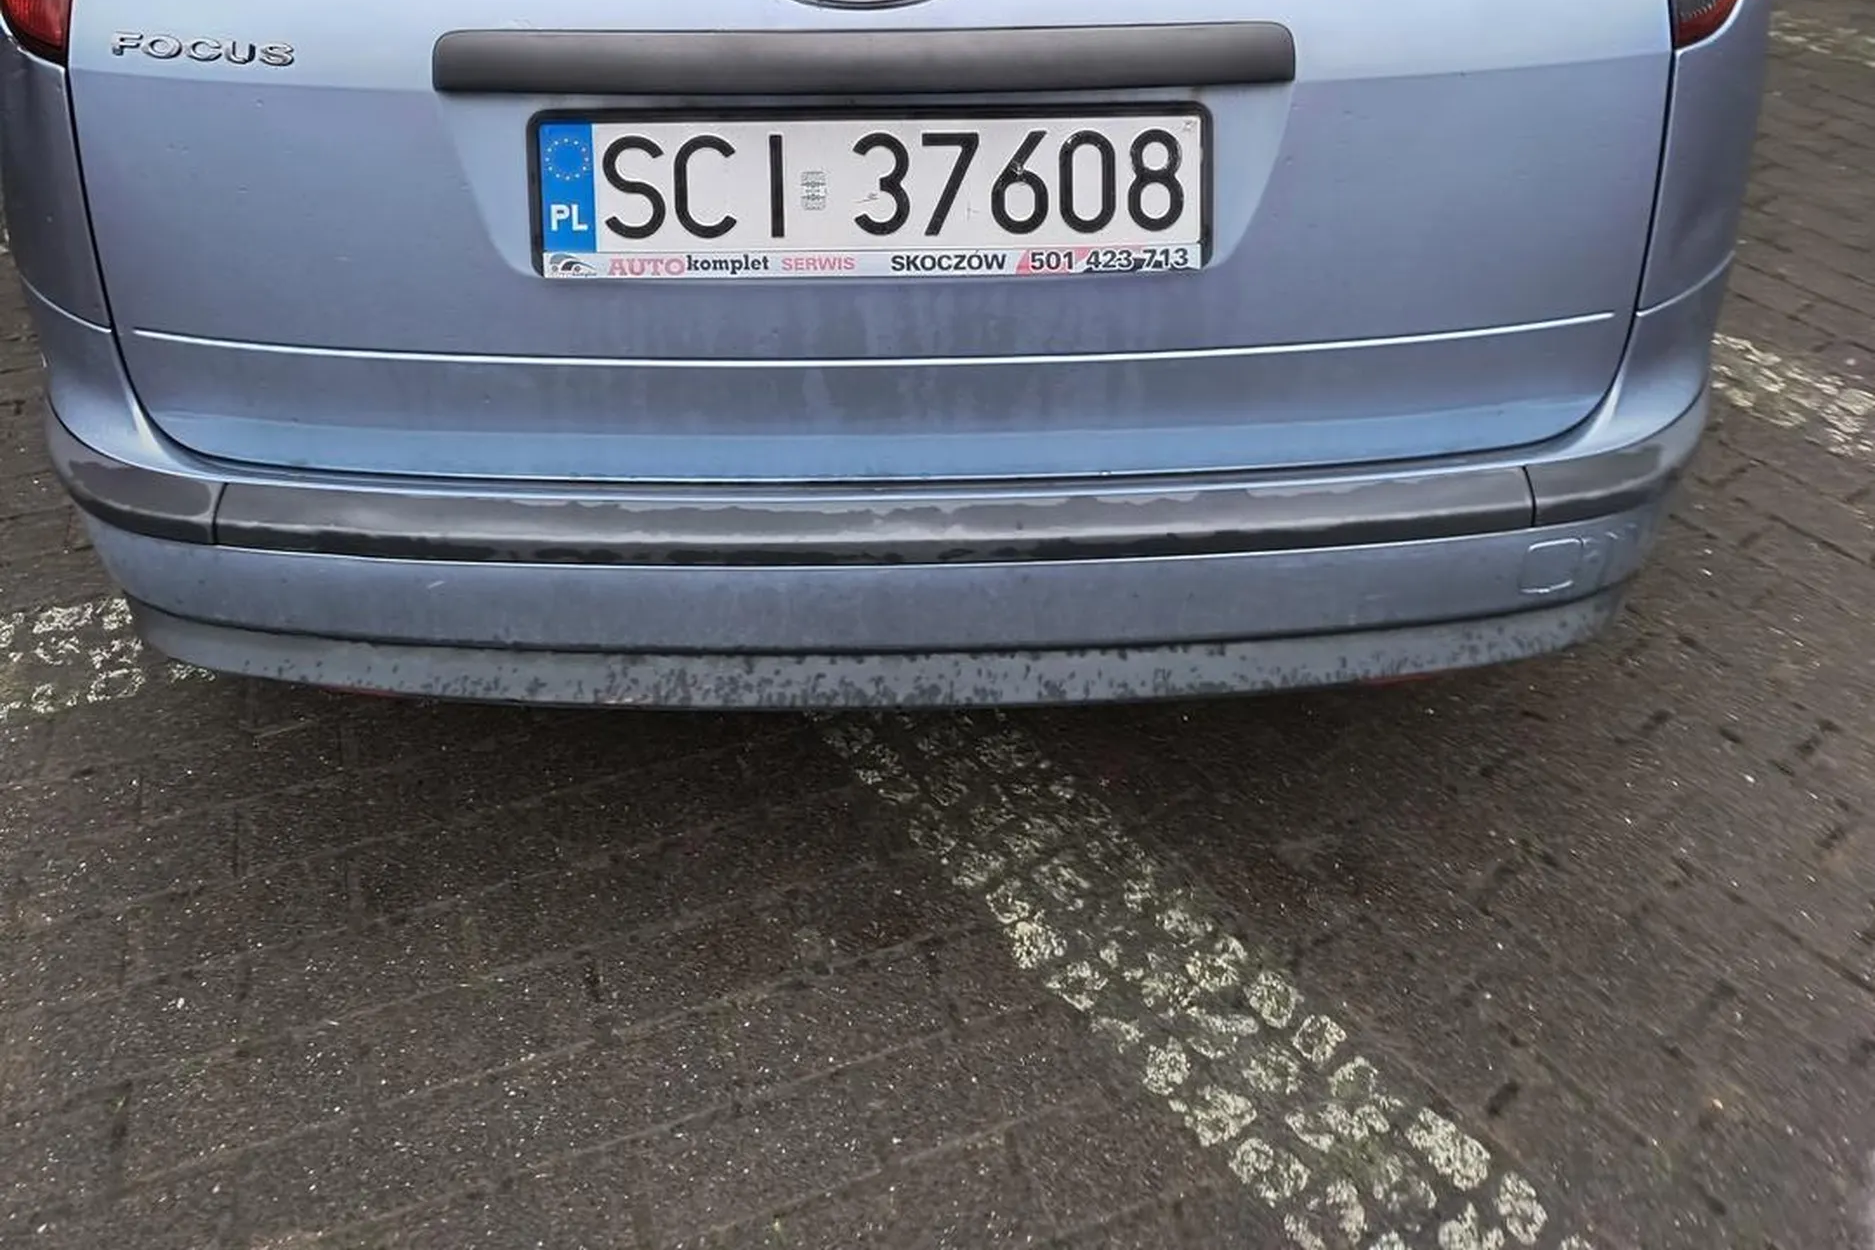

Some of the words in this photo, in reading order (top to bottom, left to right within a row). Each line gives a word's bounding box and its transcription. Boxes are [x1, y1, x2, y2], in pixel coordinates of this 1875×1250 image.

[110, 31, 295, 67] FOCUS
[602, 134, 785, 239] SCI
[852, 129, 1185, 236] 37608
[550, 204, 588, 231] PL
[781, 257, 855, 271] SERWIS
[890, 253, 1006, 272] SKOCZÓW
[1030, 252, 1075, 270] 501
[1086, 250, 1134, 269] 423
[1144, 248, 1189, 267] 713
